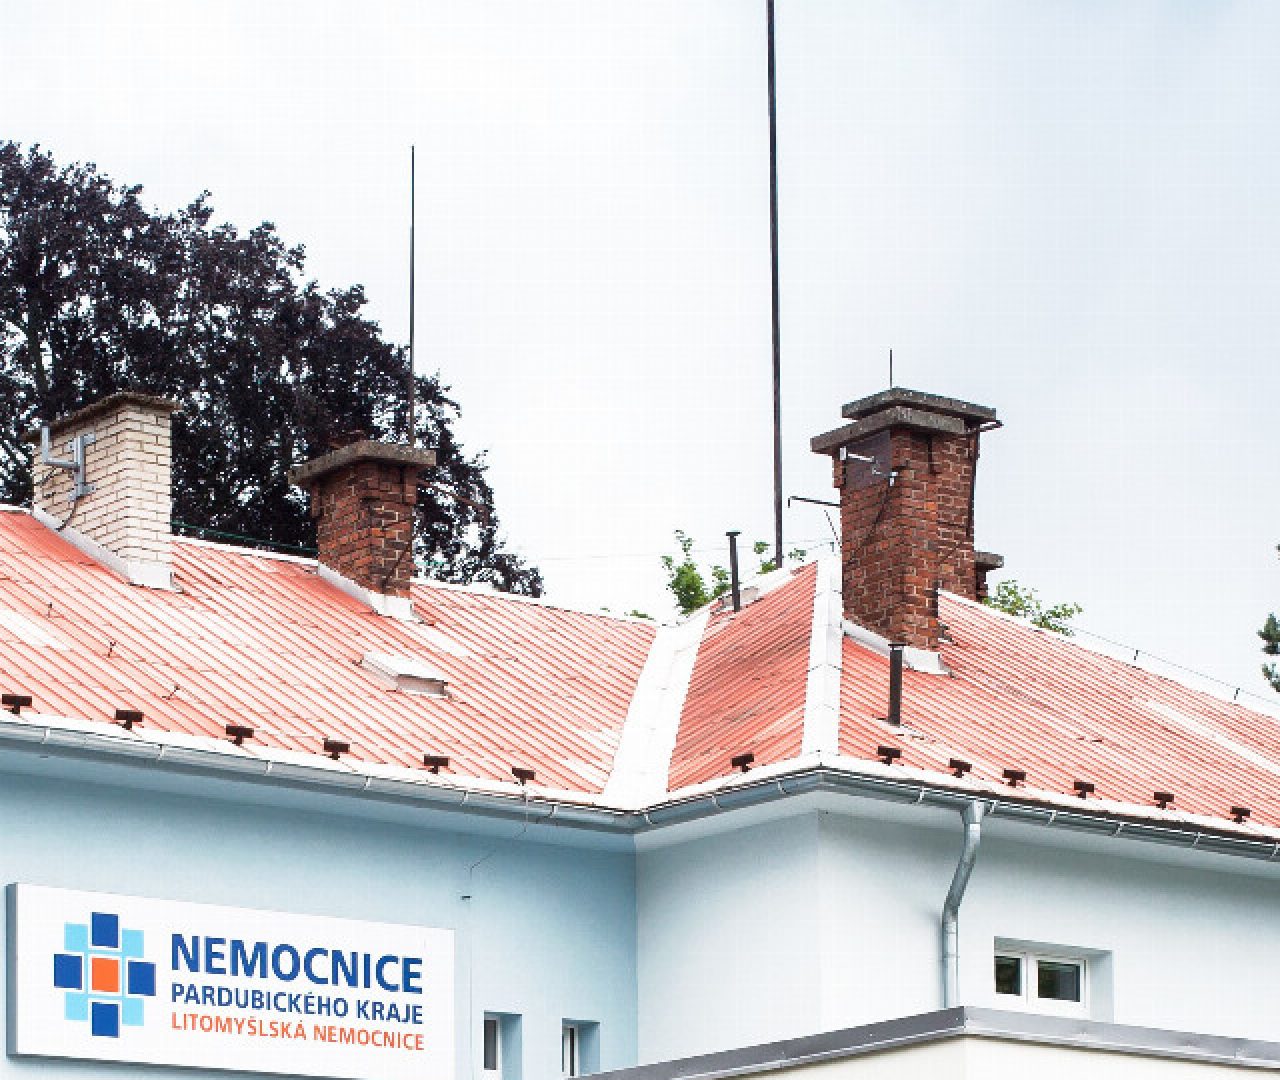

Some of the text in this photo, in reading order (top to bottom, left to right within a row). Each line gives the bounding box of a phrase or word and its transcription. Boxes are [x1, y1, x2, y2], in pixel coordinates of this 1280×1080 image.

[171, 933, 423, 993] NEMOCNICE
[171, 982, 424, 1025] PARDUBICKÉHO KRAJE
[171, 1012, 425, 1051] LITOMYŠLSKÁ NEMOCNICE
